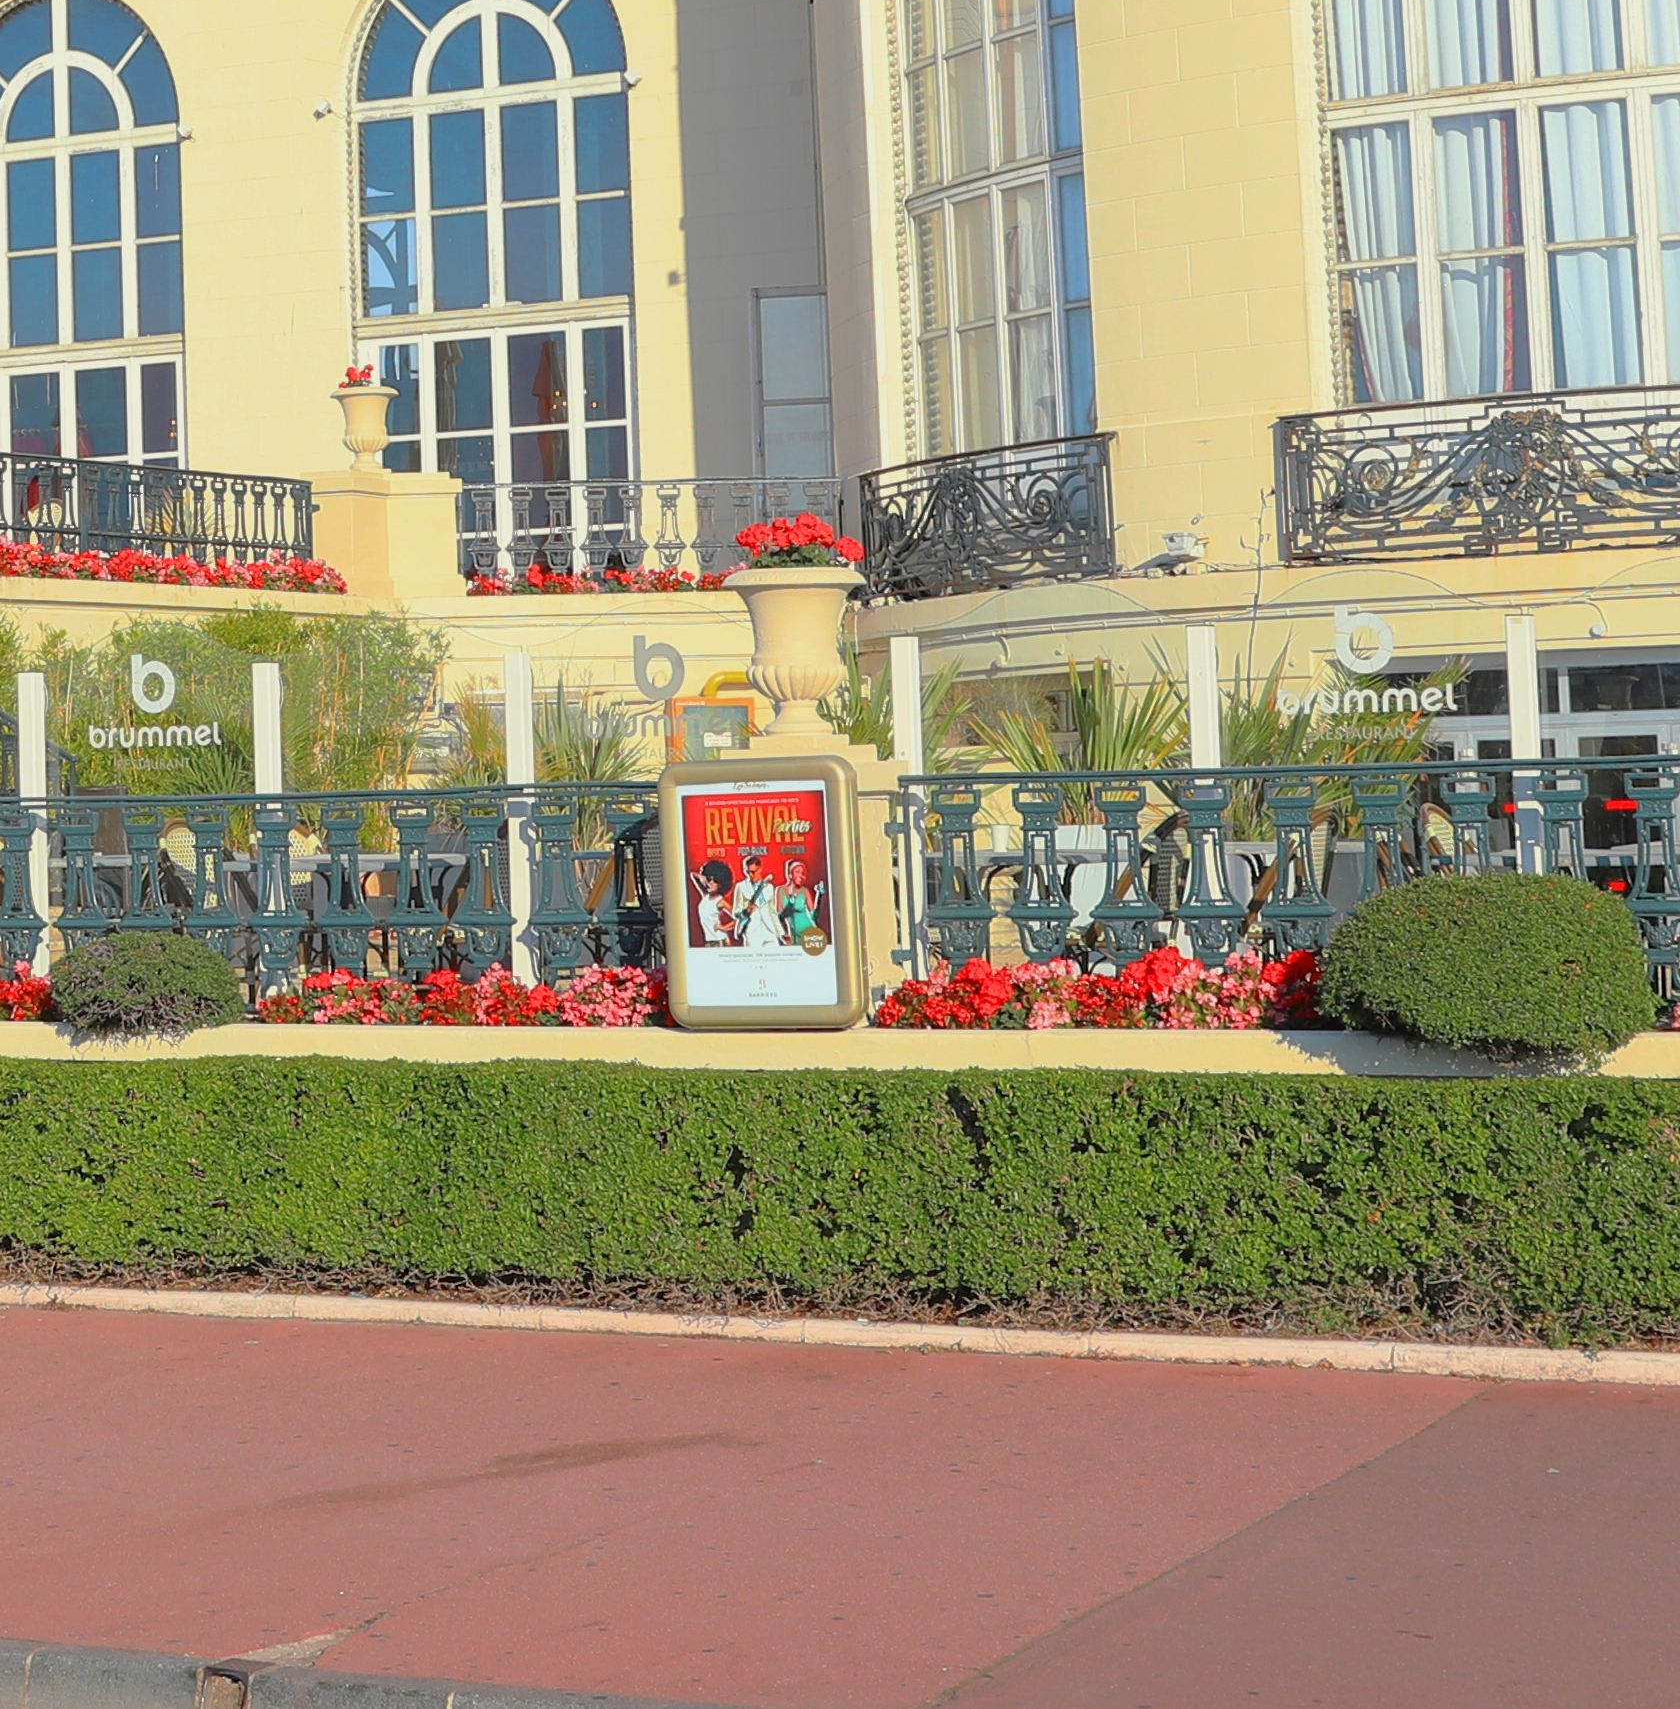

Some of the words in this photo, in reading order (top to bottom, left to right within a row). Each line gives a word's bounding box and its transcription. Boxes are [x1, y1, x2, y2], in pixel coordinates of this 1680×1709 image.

[1334, 604, 1394, 674] b
[131, 653, 175, 714] b
[633, 634, 685, 702] b
[1277, 683, 1459, 715] brummel
[89, 721, 222, 749] brummel
[705, 805, 805, 845] REVIVAL
[772, 818, 812, 834] Parties
[803, 934, 825, 942] SHOW
